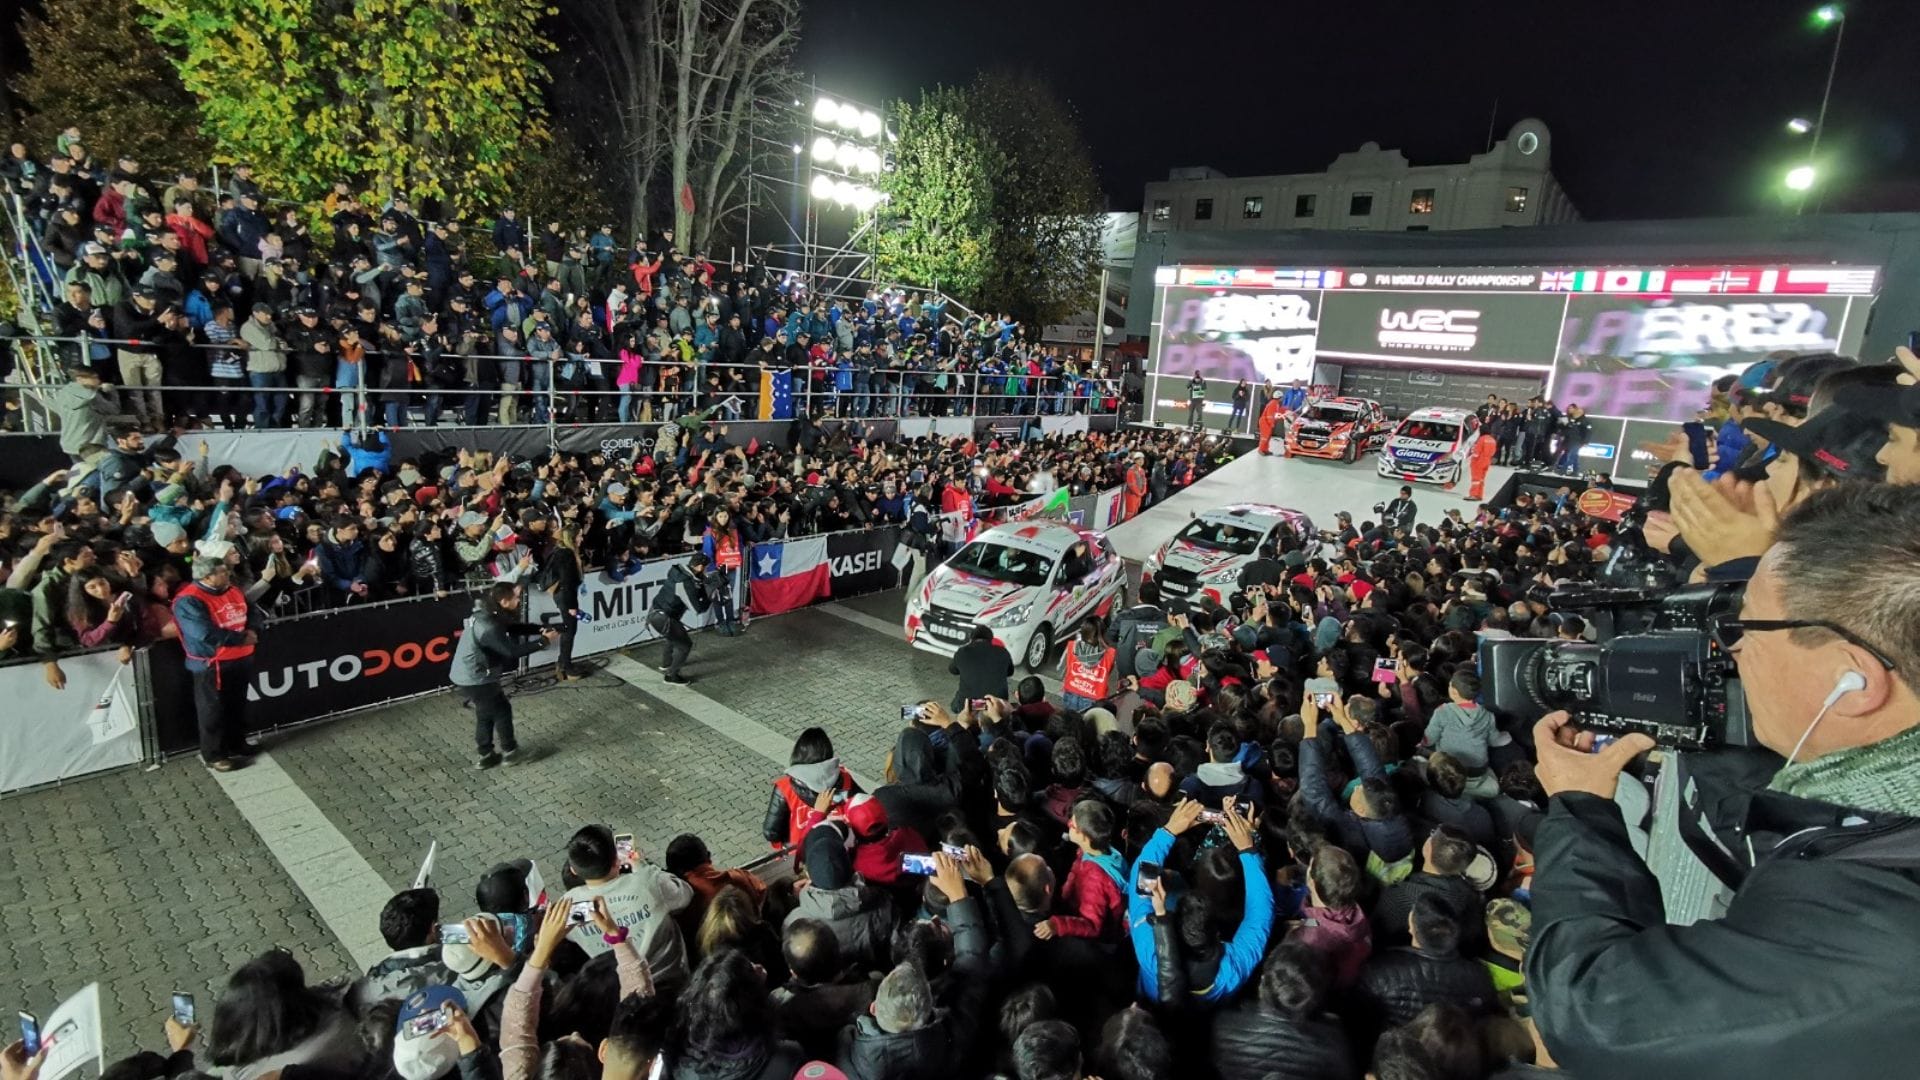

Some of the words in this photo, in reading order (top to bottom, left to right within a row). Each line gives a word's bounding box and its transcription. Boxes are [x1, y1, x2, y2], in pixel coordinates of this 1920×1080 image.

[1375, 274, 1390, 285] FIA
[1391, 275, 1425, 286] WORLD
[1426, 275, 1456, 286] RALLY
[1456, 275, 1536, 287] CHAMPIONSHIP
[1380, 308, 1481, 333] WRC
[1395, 448, 1433, 460] Gianni
[830, 549, 882, 578] KASEI
[593, 623, 611, 633] Rent
[616, 618, 632, 629] Car
[929, 622, 966, 641] DIEGO
[246, 630, 463, 702] UTODOC
